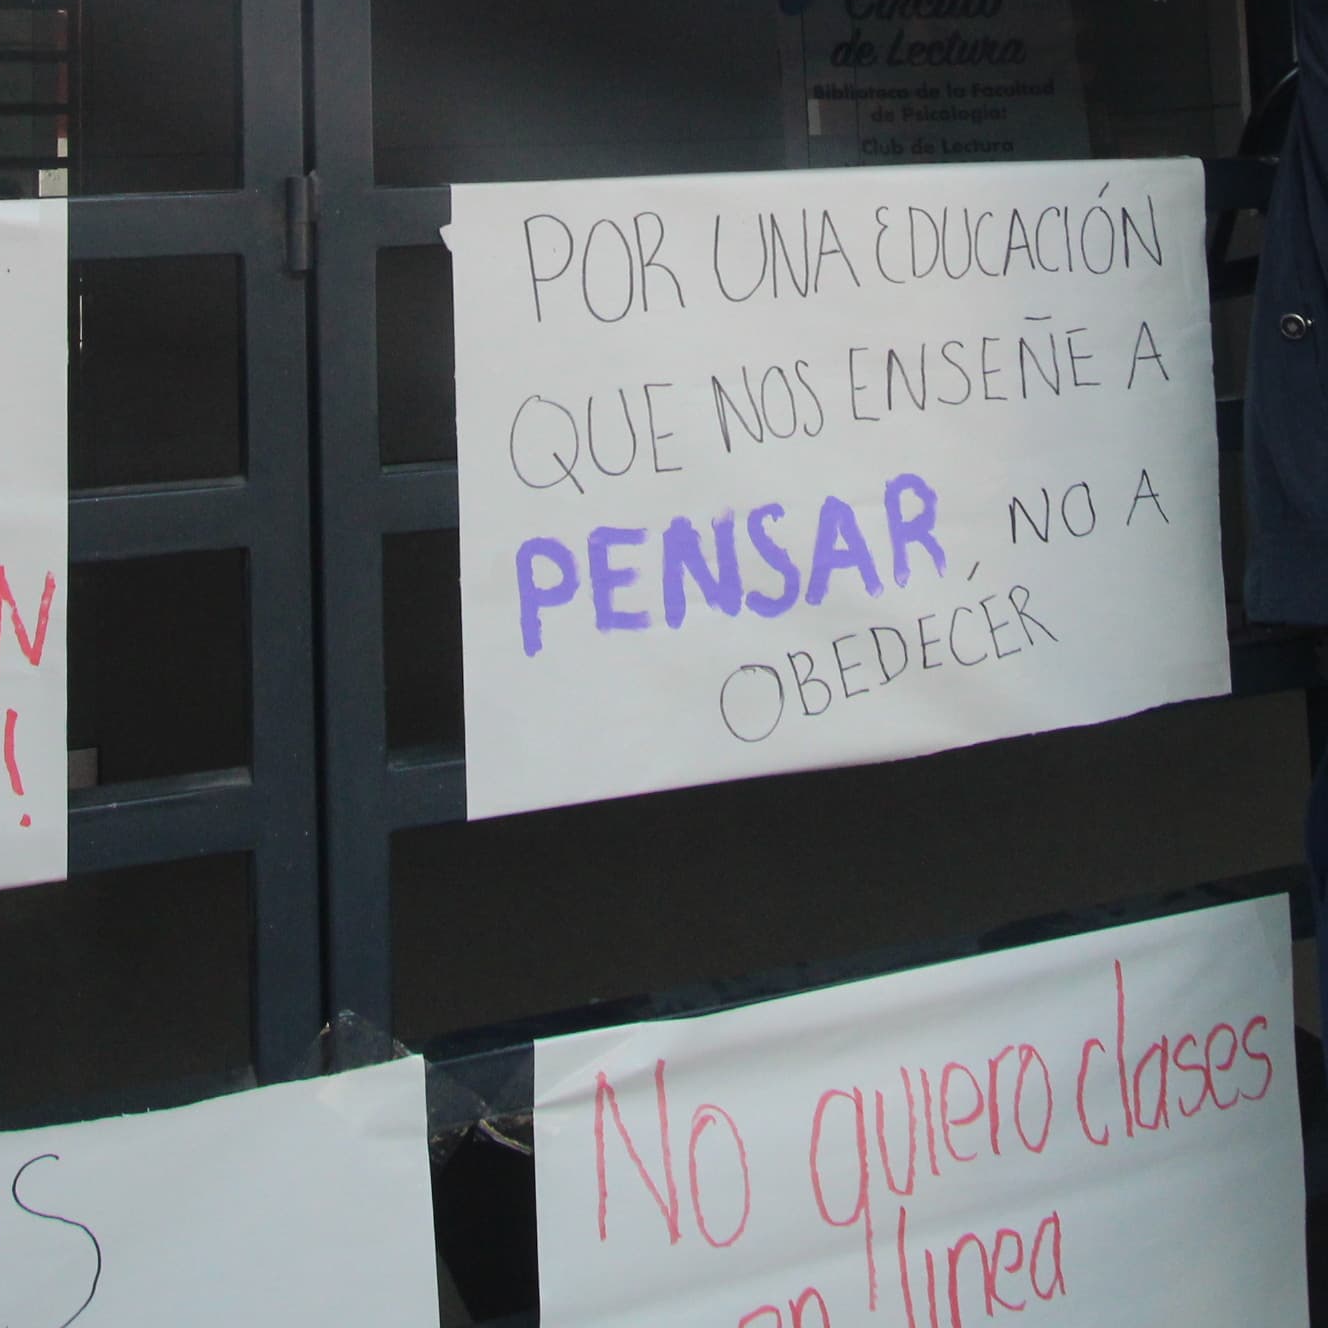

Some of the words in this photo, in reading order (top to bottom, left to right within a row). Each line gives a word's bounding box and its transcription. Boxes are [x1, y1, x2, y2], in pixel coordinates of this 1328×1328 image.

[886, 29, 1028, 68] Lectura
[522, 208, 688, 324] POR
[712, 207, 862, 304] UNA
[874, 180, 1164, 286] EDUCACIÓN
[508, 381, 685, 496] QUE
[710, 357, 826, 455] NOS
[848, 313, 1103, 424] ENSEÑE
[1125, 320, 1171, 391] A
[1008, 479, 1099, 546] NO
[1125, 467, 1171, 528] A
[594, 1058, 752, 1249] No
[809, 1043, 1054, 1313] quiero
[1076, 958, 1275, 1149] clases
